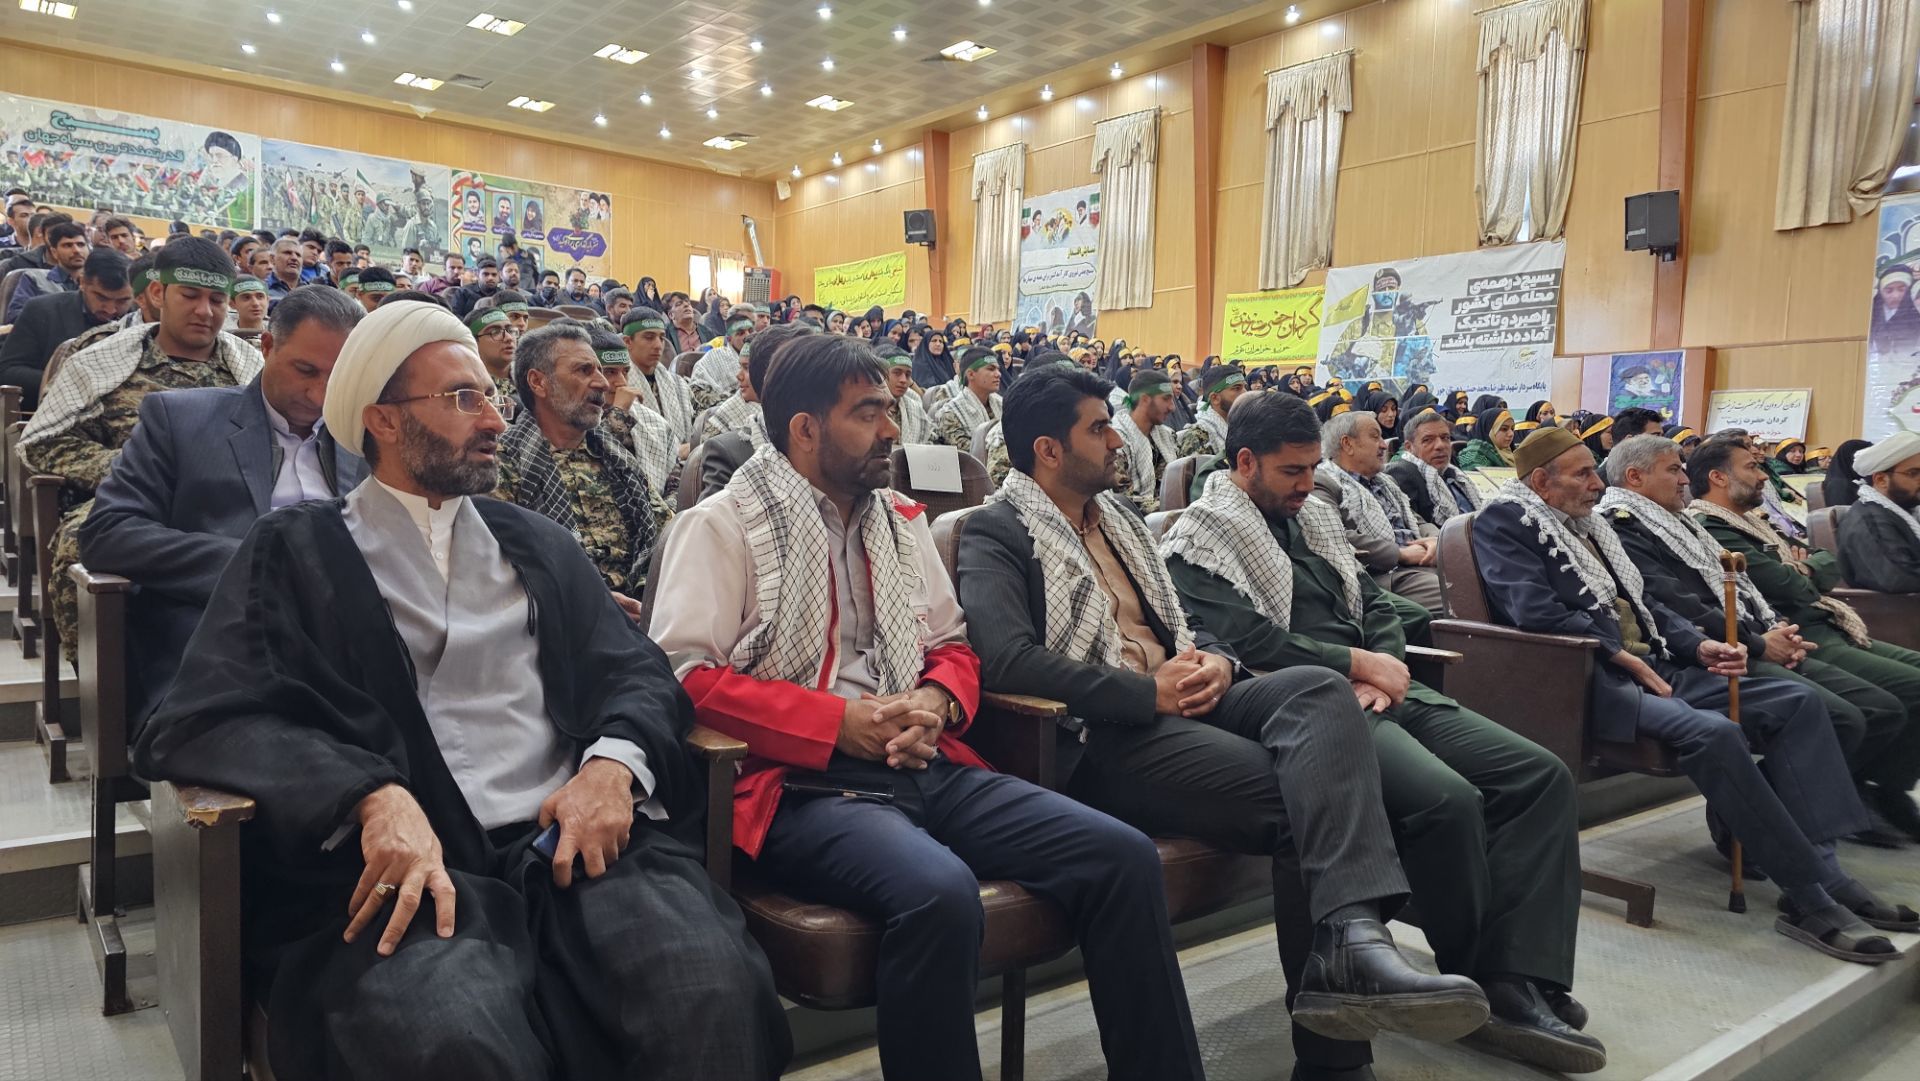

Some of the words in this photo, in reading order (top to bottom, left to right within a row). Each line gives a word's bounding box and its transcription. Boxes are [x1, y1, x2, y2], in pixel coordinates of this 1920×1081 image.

[50, 110, 160, 145] بسیج
[24, 128, 60, 146] جهان
[60, 132, 94, 150] سپاه
[94, 142, 185, 162] قدرتمندترین
[1504, 275, 1521, 290] در
[1520, 274, 1556, 290] بسیج
[1454, 294, 1491, 314] کشور
[1490, 293, 1520, 310] های
[1521, 291, 1555, 304] محله
[1456, 313, 1502, 331] تاکتیک
[1501, 317, 1509, 330] و
[1509, 309, 1551, 328] راهبرد
[1475, 330, 1513, 345] داشته
[1513, 327, 1551, 342] آماده
